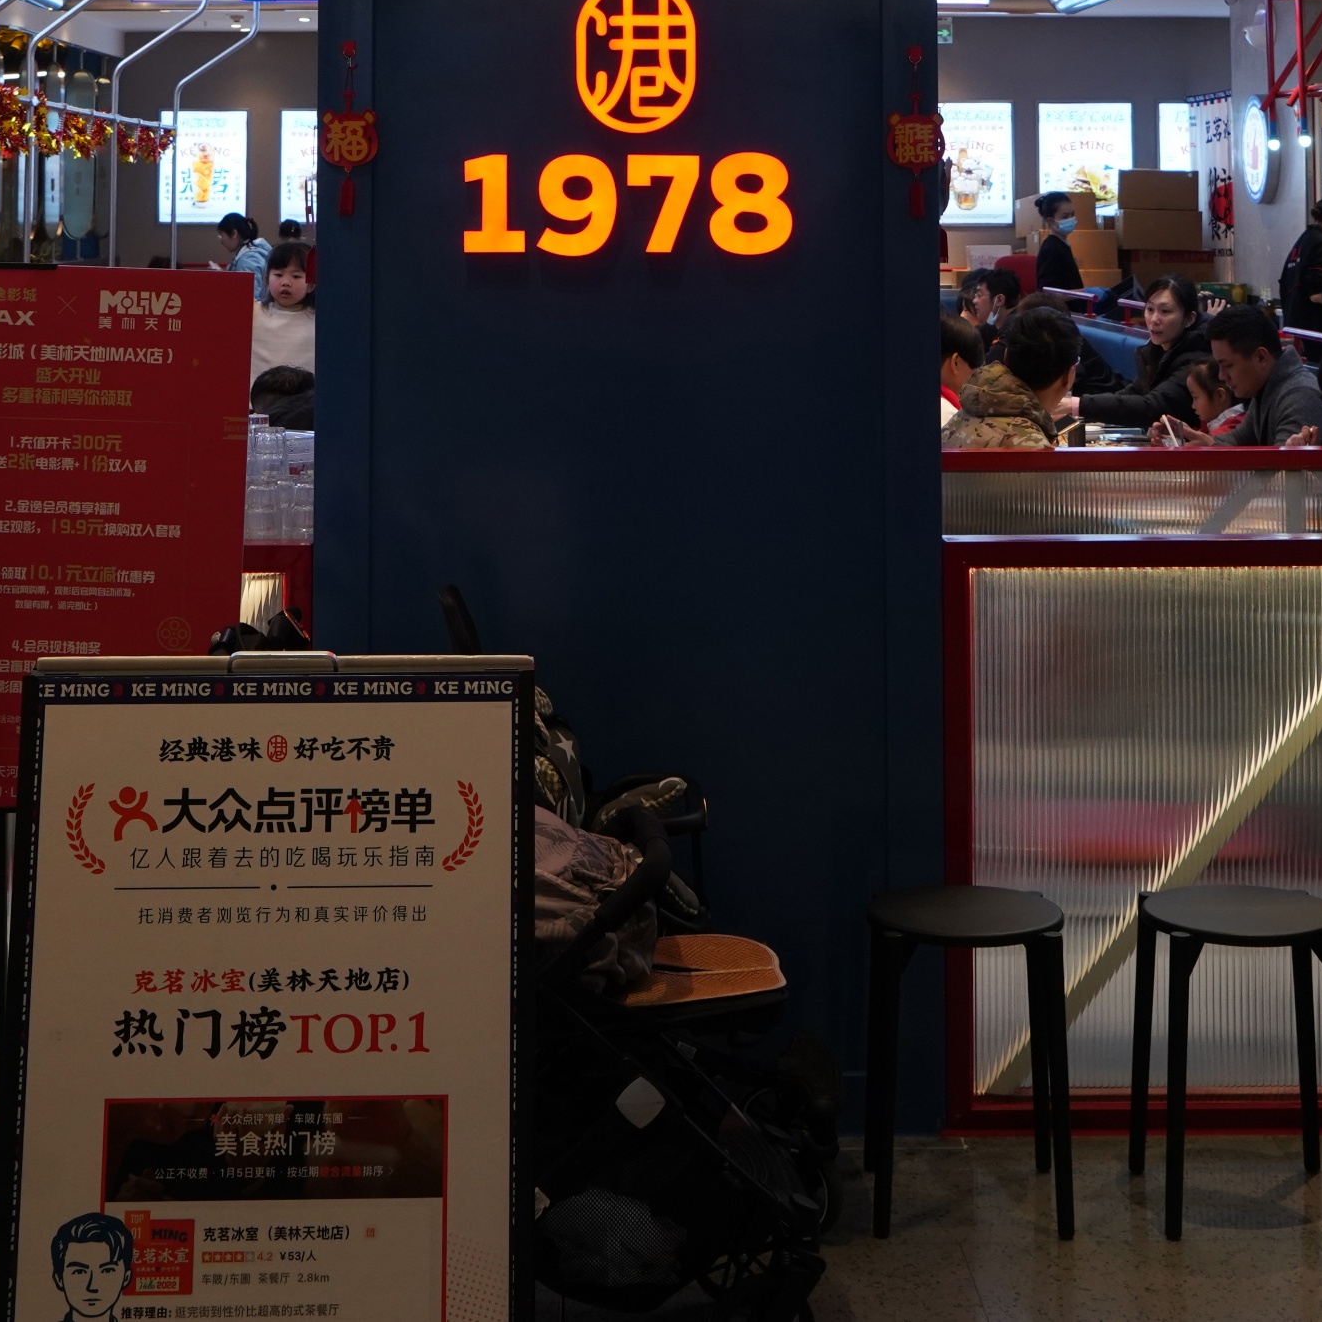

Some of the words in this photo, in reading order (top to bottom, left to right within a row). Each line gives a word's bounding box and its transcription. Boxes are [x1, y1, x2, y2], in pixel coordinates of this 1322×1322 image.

[326, 120, 367, 162] 福
[894, 123, 935, 143] 新年
[895, 142, 935, 164] 快乐
[463, 151, 794, 257] 1978
[98, 316, 182, 333] 美林天地
[35, 366, 102, 385] 盛大开业
[1, 387, 133, 407] 多重福利等你领取
[5, 499, 121, 516] 2.金逸会员尊享福利
[11, 639, 102, 655] 4.会员现场抽奖
[131, 681, 158, 697] KE
[231, 681, 259, 697] KE
[332, 681, 359, 696] KE
[433, 680, 460, 695] KE
[158, 736, 263, 763] 经典港味
[293, 735, 396, 762] 好吃不贵
[161, 785, 436, 835] 大众点评榜单
[129, 845, 436, 870] 亿人跟着去的吃喝玩乐指南
[137, 904, 428, 924] 托消费者浏览行为和真实评价得出
[213, 1130, 337, 1158] 美食热门榜
[130, 1213, 145, 1224] TOP
[256, 1251, 273, 1263] 4.2
[156, 1280, 177, 1290] 2022
[257, 1273, 291, 1285] 茶餐厅
[297, 1272, 330, 1284] 2.8km
